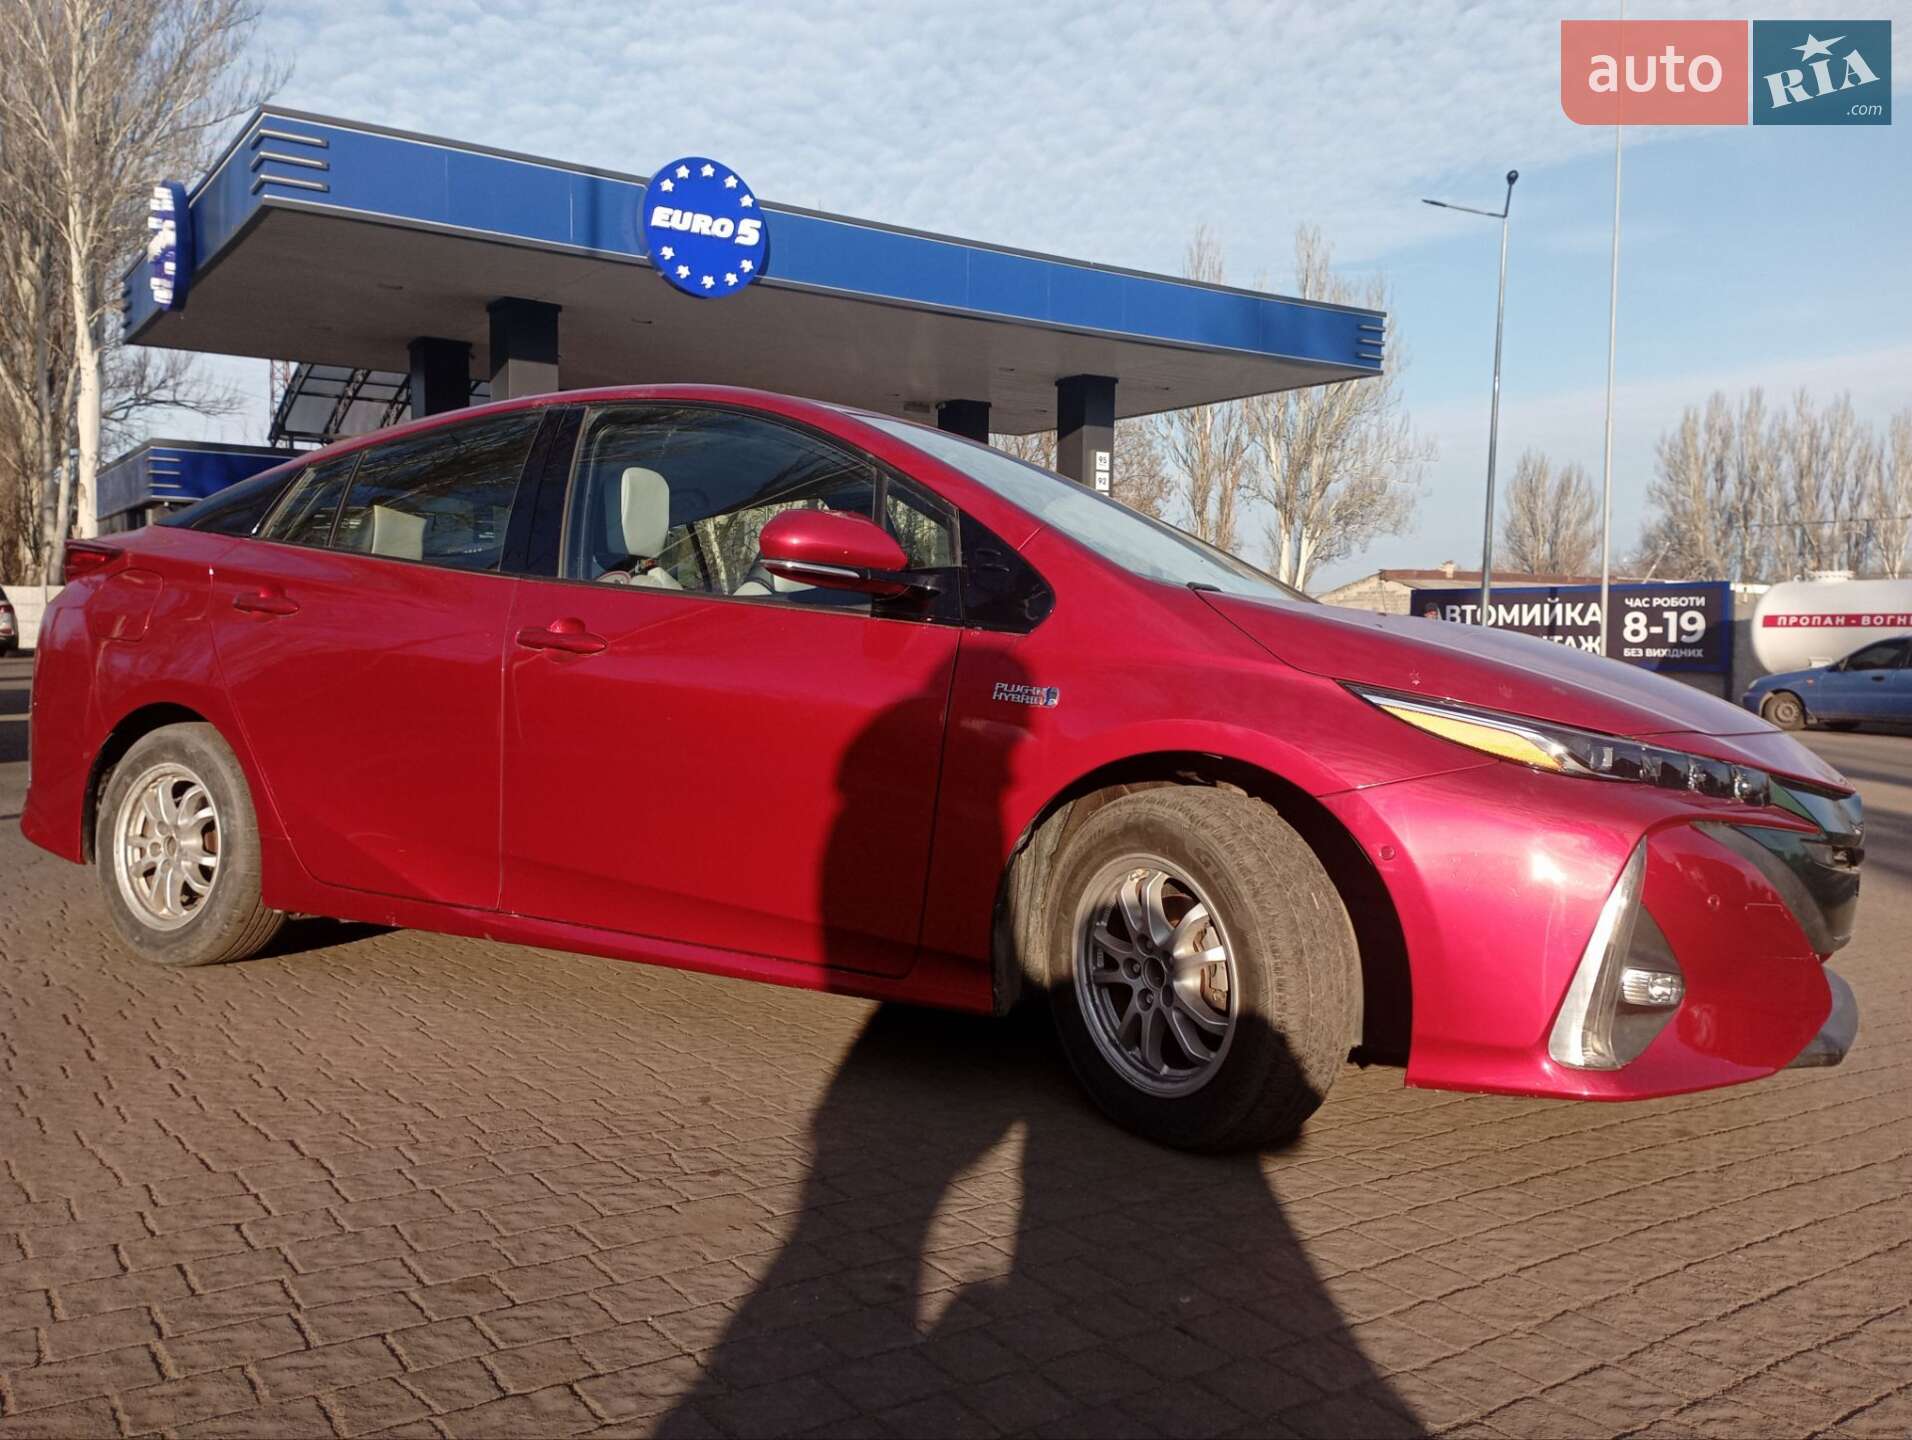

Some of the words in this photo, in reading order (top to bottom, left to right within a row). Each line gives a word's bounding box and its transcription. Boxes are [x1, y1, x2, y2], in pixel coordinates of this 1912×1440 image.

[651, 206, 735, 238] EURO
[734, 218, 762, 246] 5
[1624, 597, 1650, 608] ЧАС
[1652, 596, 1706, 607] РОБОТИ
[1434, 597, 1602, 627] ВТОМИЙКА
[1623, 610, 1706, 643] 8-19
[1777, 616, 1845, 626] ПРОПАН
[1623, 648, 1643, 657] БЕЗ
[992, 690, 1043, 705] HYBRID
